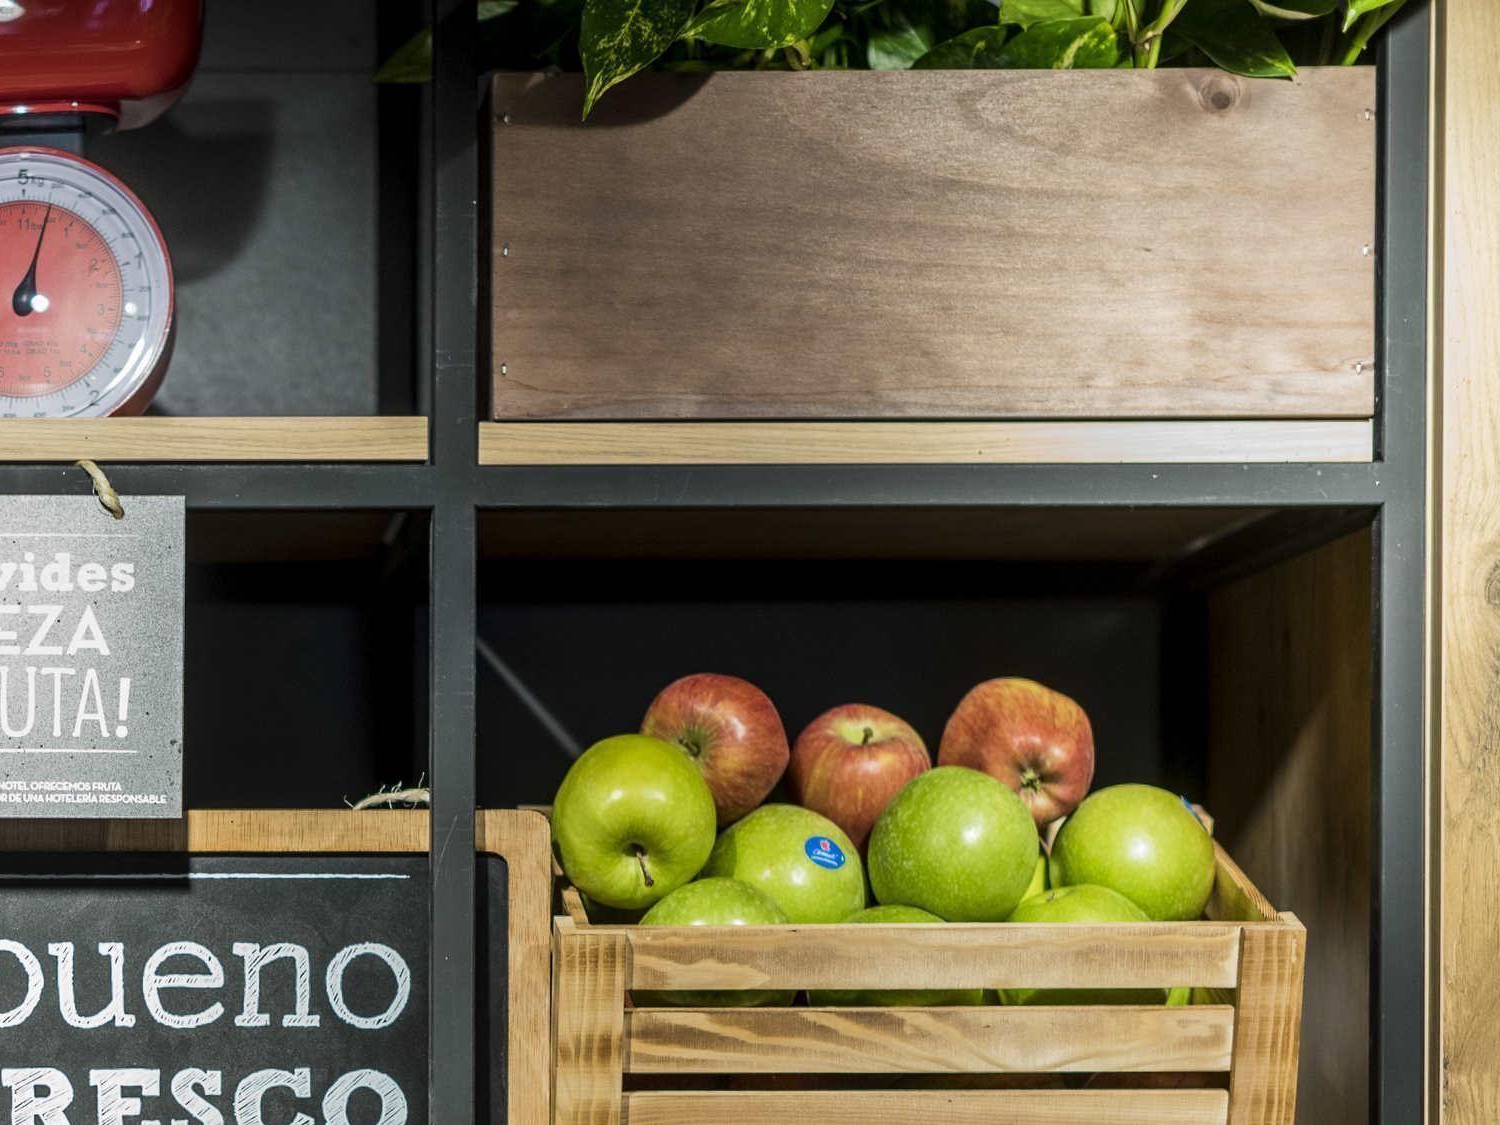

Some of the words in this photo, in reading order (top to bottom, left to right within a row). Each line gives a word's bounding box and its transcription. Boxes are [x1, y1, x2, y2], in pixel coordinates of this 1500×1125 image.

[18, 168, 29, 185] 5
[43, 366, 52, 378] 5
[30, 781, 91, 791] OFRECEMOS
[91, 782, 122, 792] FRUTA
[8, 792, 22, 802] DE
[22, 792, 45, 803] UNA
[98, 793, 168, 804] RESPONSABLE
